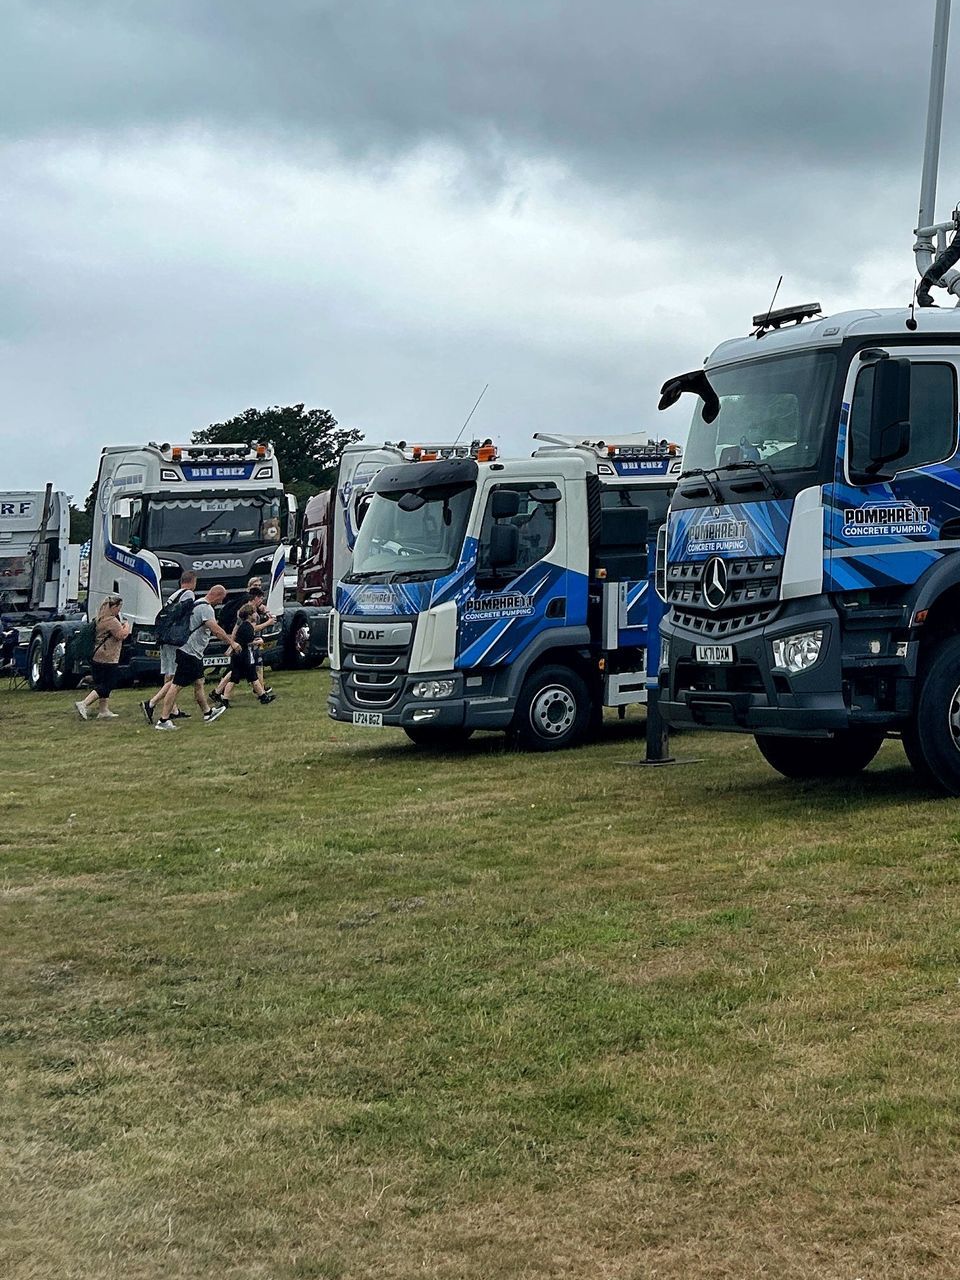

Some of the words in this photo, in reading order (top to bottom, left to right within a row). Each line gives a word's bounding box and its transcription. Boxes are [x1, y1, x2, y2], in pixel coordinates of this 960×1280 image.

[844, 507, 930, 525] POMPHRETT
[688, 521, 747, 541] POMPHRETT
[844, 526, 889, 536] CONCRETE
[890, 524, 927, 534] PUMPING
[687, 542, 716, 553] CONCRETE
[716, 540, 744, 551] PUMPING
[192, 559, 244, 570] SCANIA
[465, 595, 535, 612] POMPHRETT
[465, 612, 501, 620] CONCRETE
[501, 608, 532, 617] PUMPING
[358, 630, 385, 640] DAF
